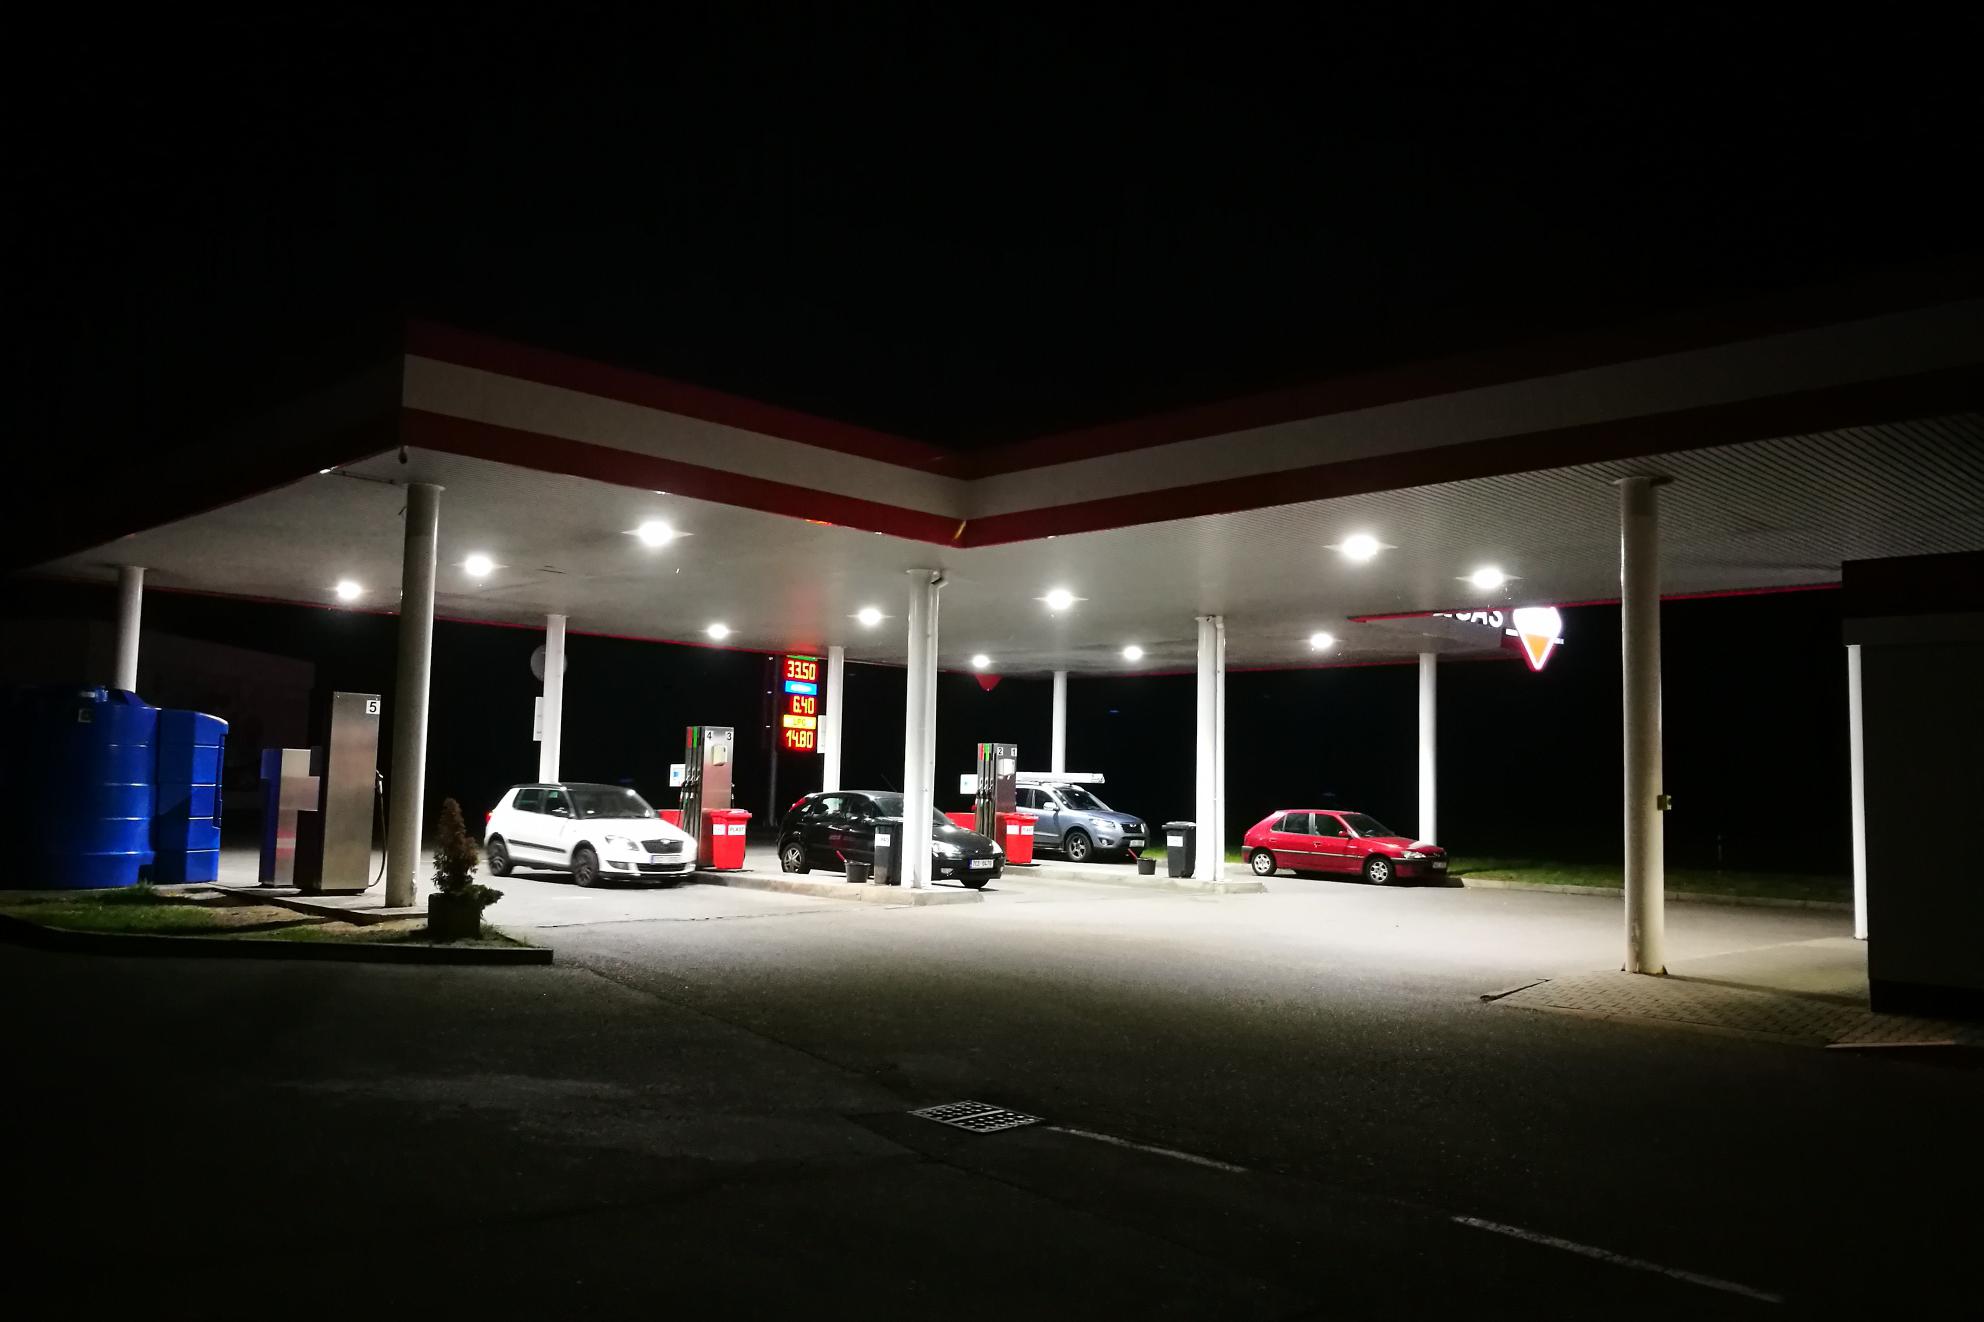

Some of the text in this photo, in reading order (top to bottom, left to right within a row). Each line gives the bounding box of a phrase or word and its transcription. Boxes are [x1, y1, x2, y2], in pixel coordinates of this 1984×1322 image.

[787, 660, 816, 681] 33.50
[369, 701, 377, 713] 5
[793, 695, 815, 715] 6.40
[706, 731, 732, 741] 4 3
[786, 729, 814, 749] 14.80
[998, 747, 1003, 755] 2
